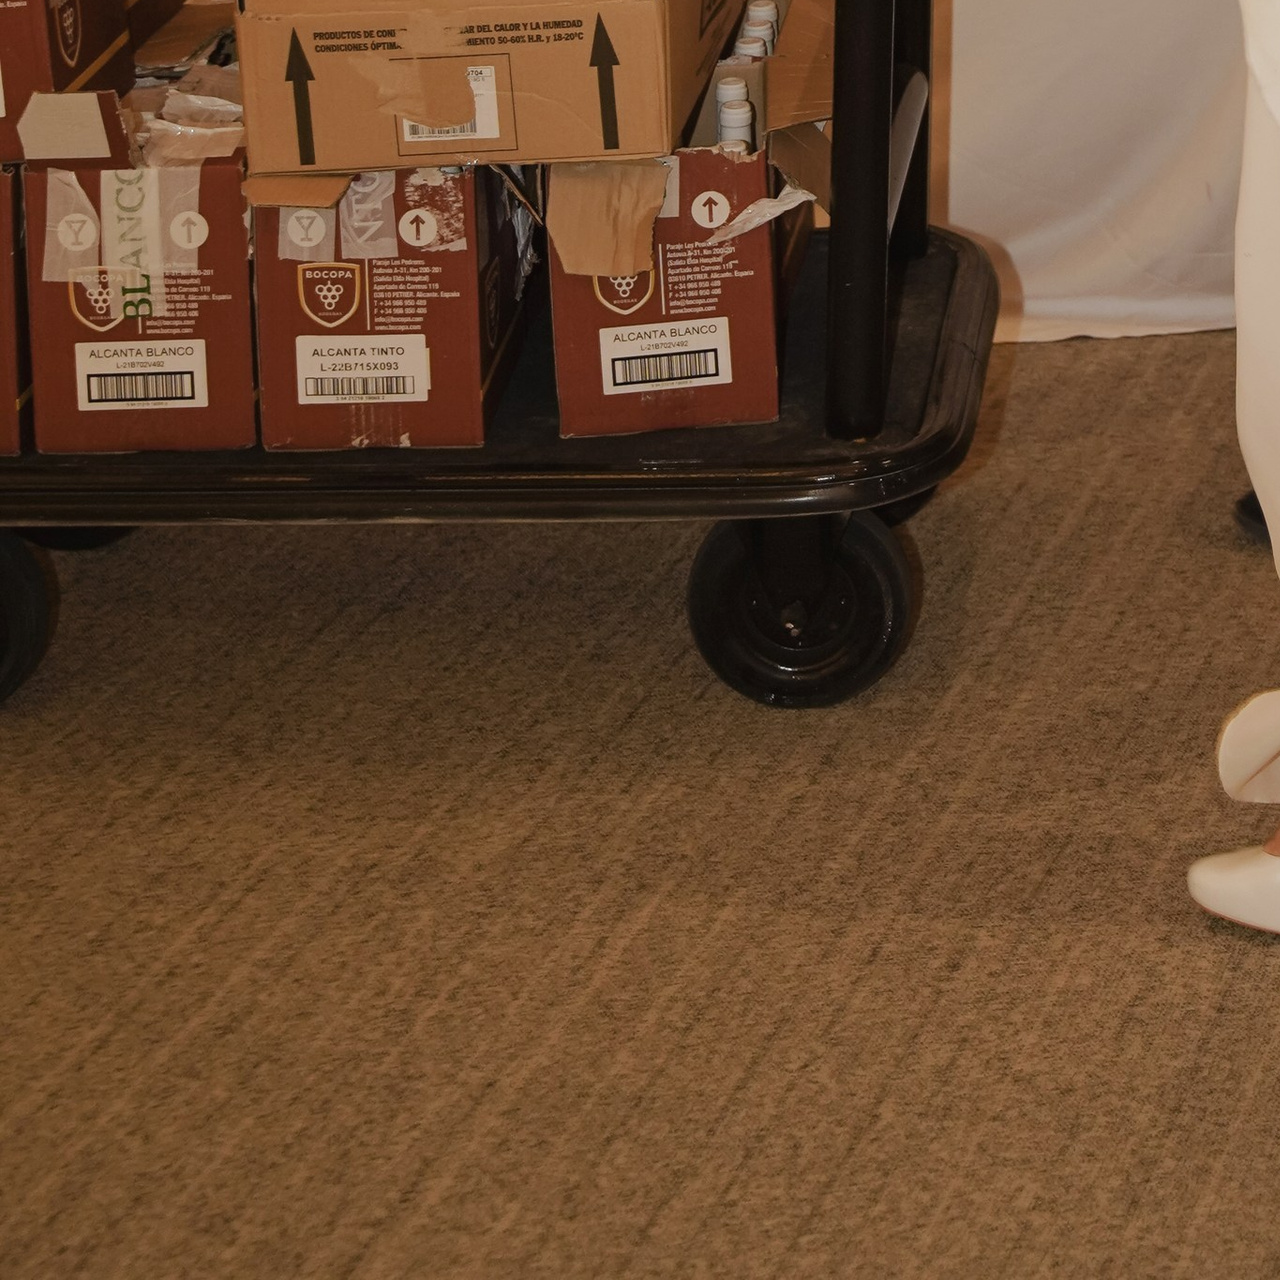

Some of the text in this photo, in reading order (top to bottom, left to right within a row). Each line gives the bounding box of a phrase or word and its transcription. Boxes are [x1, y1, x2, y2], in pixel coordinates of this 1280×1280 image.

[476, 24, 492, 34] DEL
[494, 23, 520, 33] CALOR
[521, 23, 529, 31] Y
[530, 22, 541, 31] LA
[542, 19, 583, 30] HUMEDAD
[313, 31, 361, 41] PRODUCTOS
[363, 30, 376, 39] DE
[498, 36, 527, 45] 50-60%
[528, 34, 544, 44] H.R.
[545, 34, 551, 44] y
[314, 42, 369, 53] CONDICIONES
[305, 270, 353, 279] BOCOPA
[613, 324, 718, 343] ALCANTA BLANCO
[89, 346, 195, 359] ALCANTA BLANCO
[312, 346, 405, 357] ALCANTA TINTO
[320, 361, 399, 372] L-22B715X093
